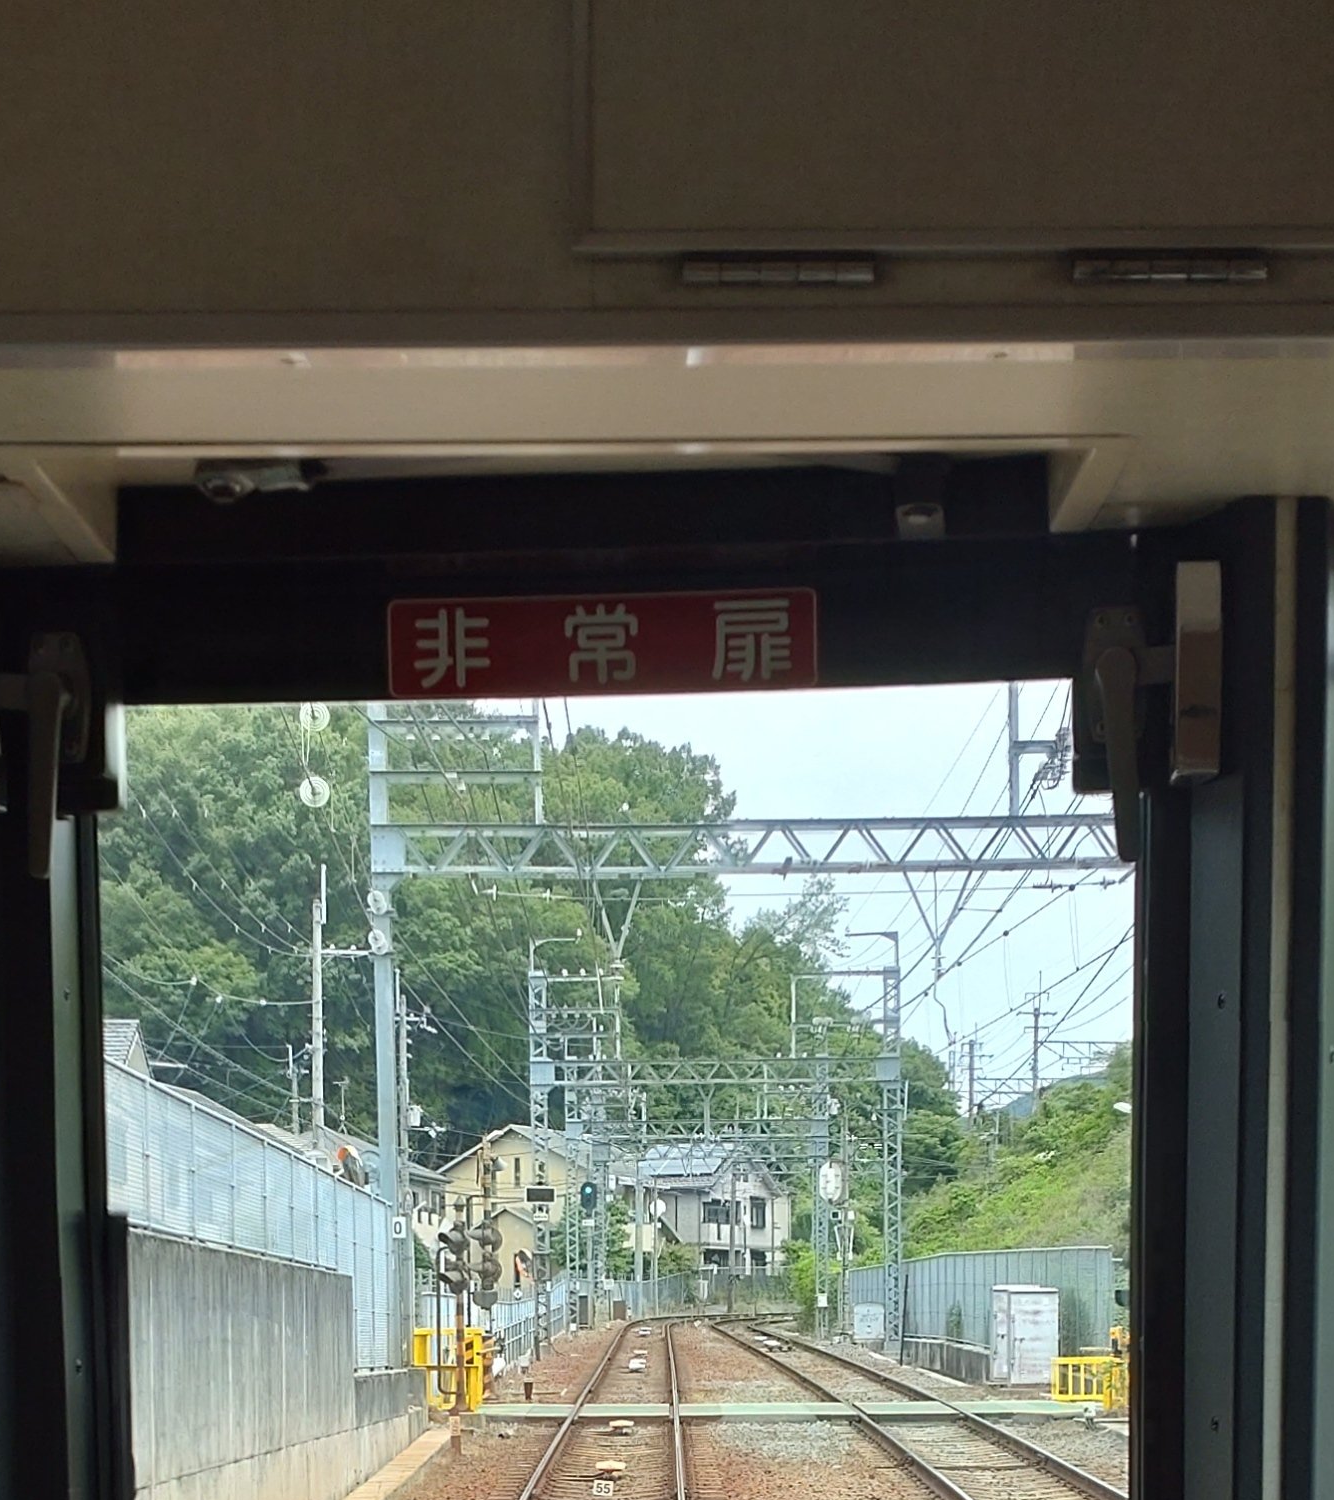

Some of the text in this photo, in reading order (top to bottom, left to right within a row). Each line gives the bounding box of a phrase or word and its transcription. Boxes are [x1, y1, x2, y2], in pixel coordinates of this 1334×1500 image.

[414, 599, 792, 688] 非常扉
[394, 1221, 402, 1235] 0
[596, 1482, 611, 1494] 55
